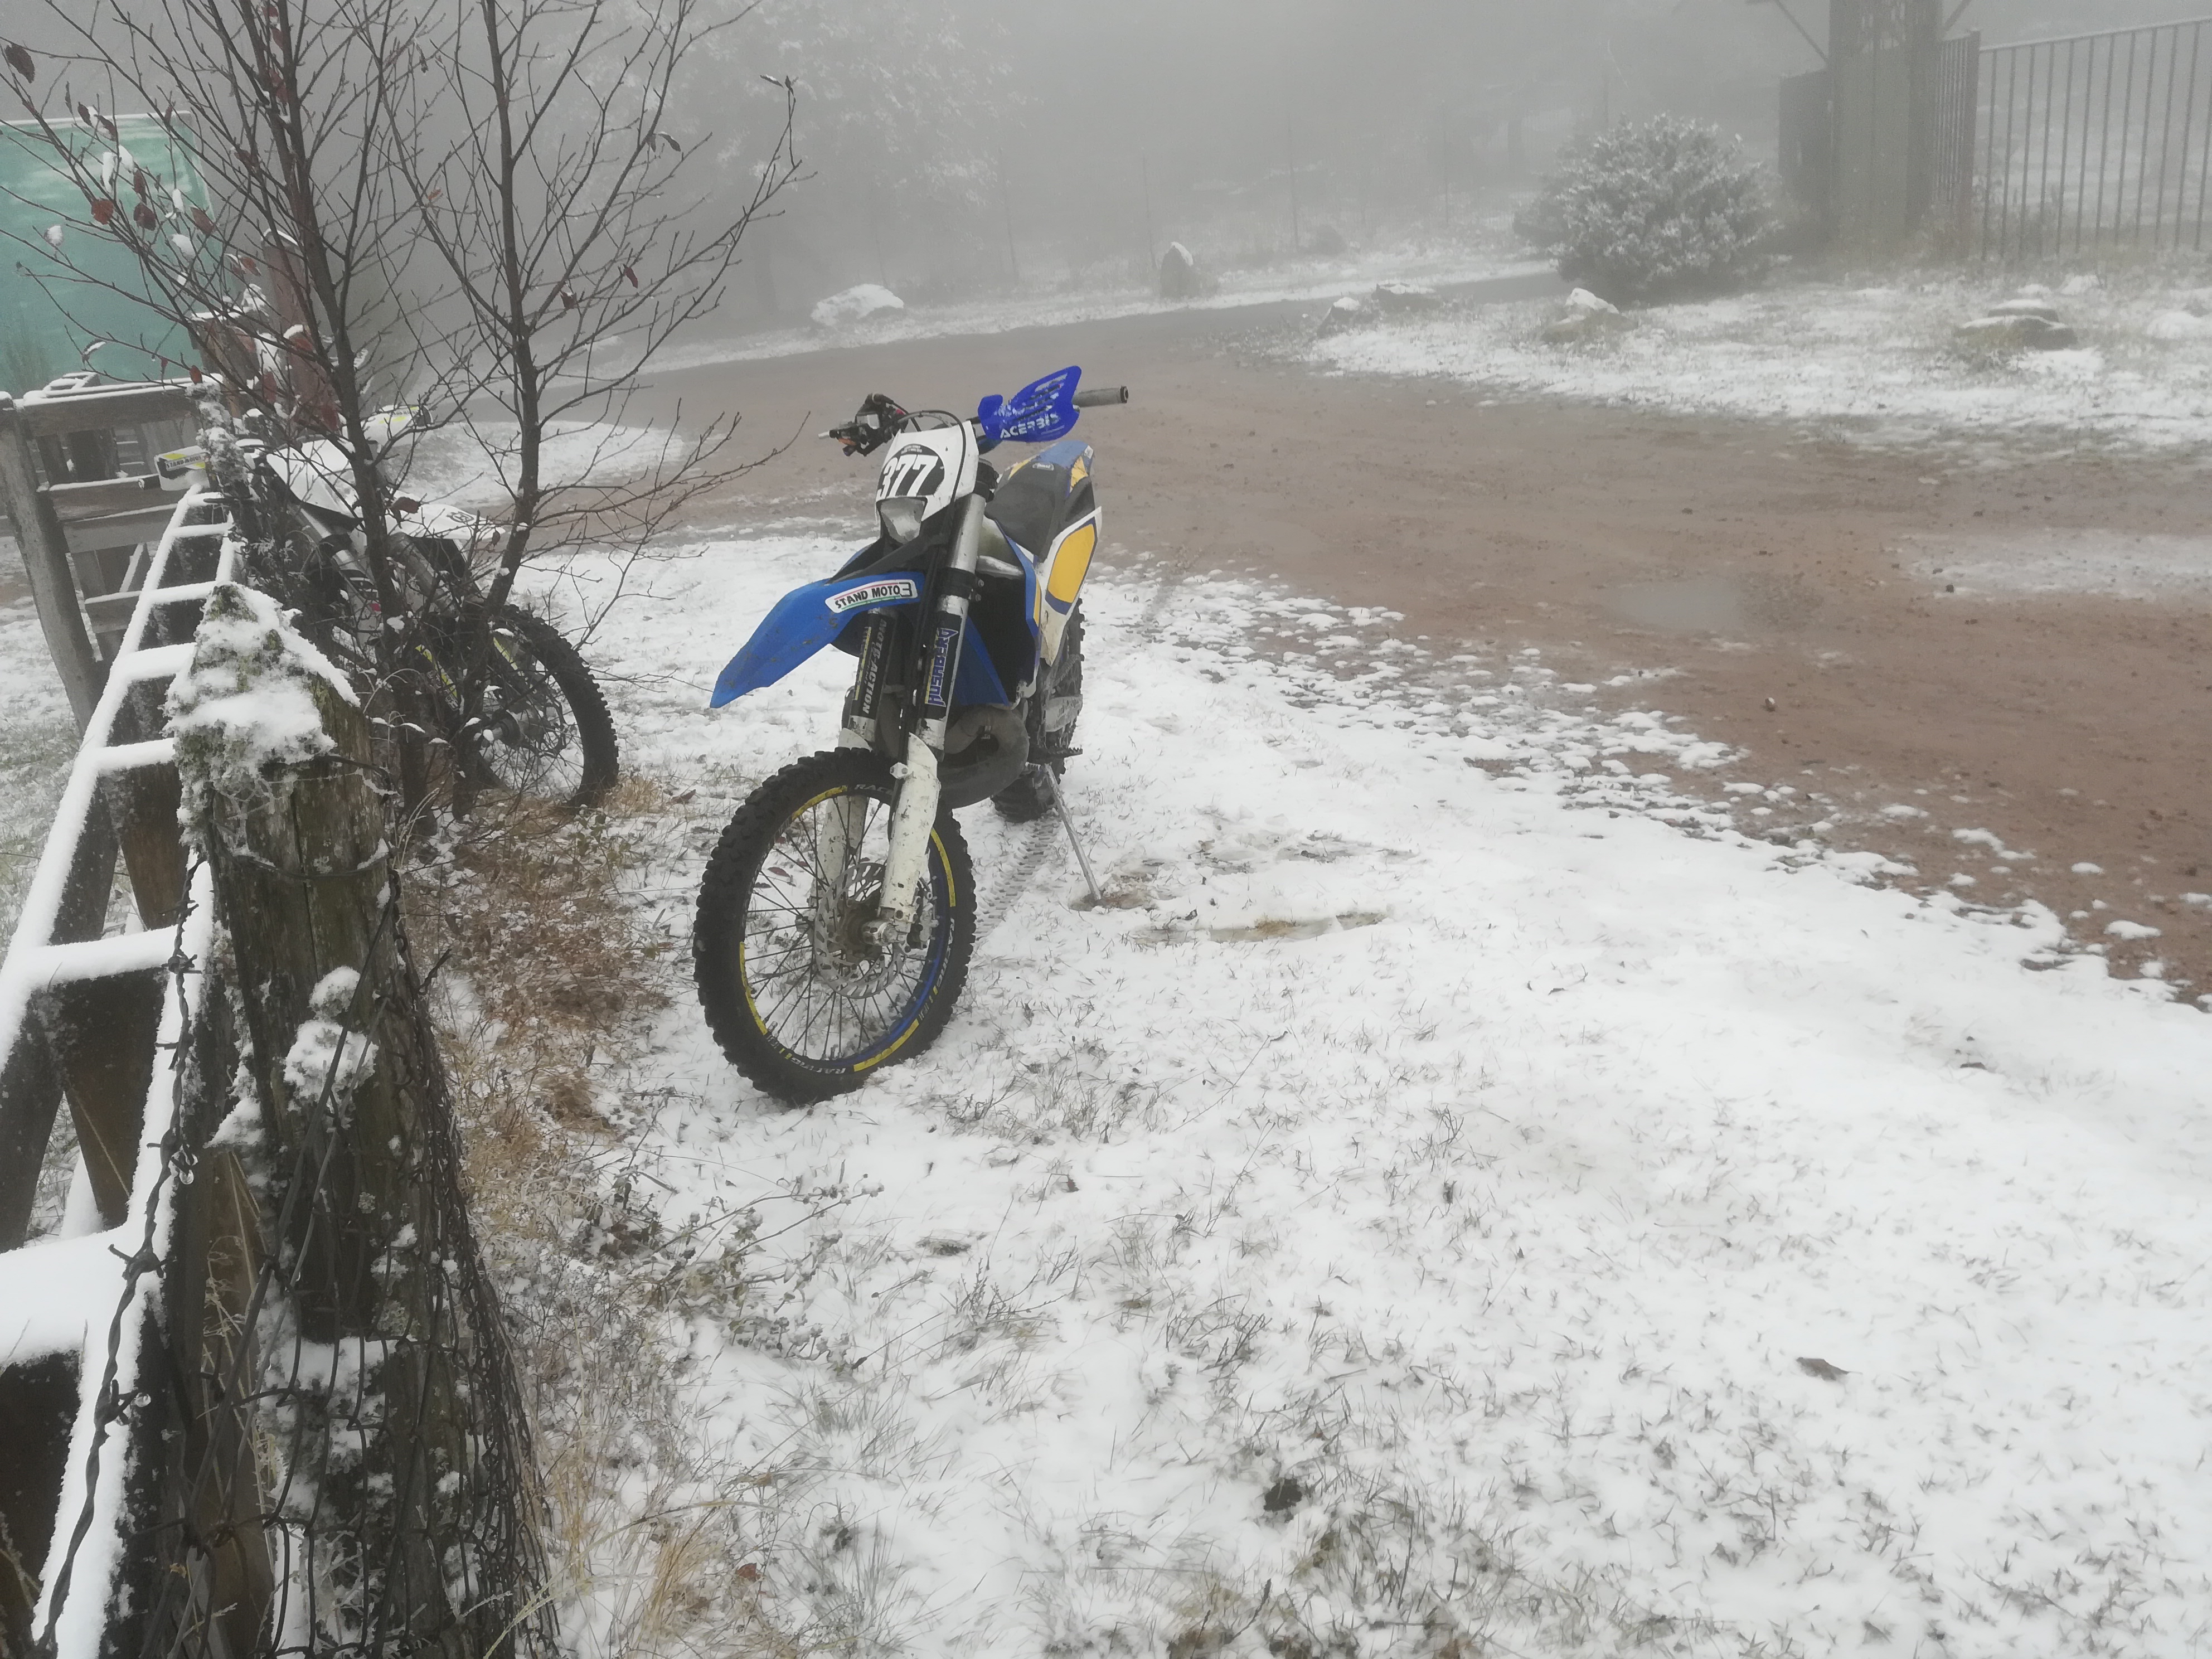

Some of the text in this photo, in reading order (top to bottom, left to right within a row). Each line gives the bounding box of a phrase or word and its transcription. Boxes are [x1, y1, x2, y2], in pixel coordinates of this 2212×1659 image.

[876, 454, 939, 502] 377
[835, 590, 868, 609] STAND
[863, 619, 887, 715] MOTO-ACTION
[925, 627, 959, 708] HUSABERG
